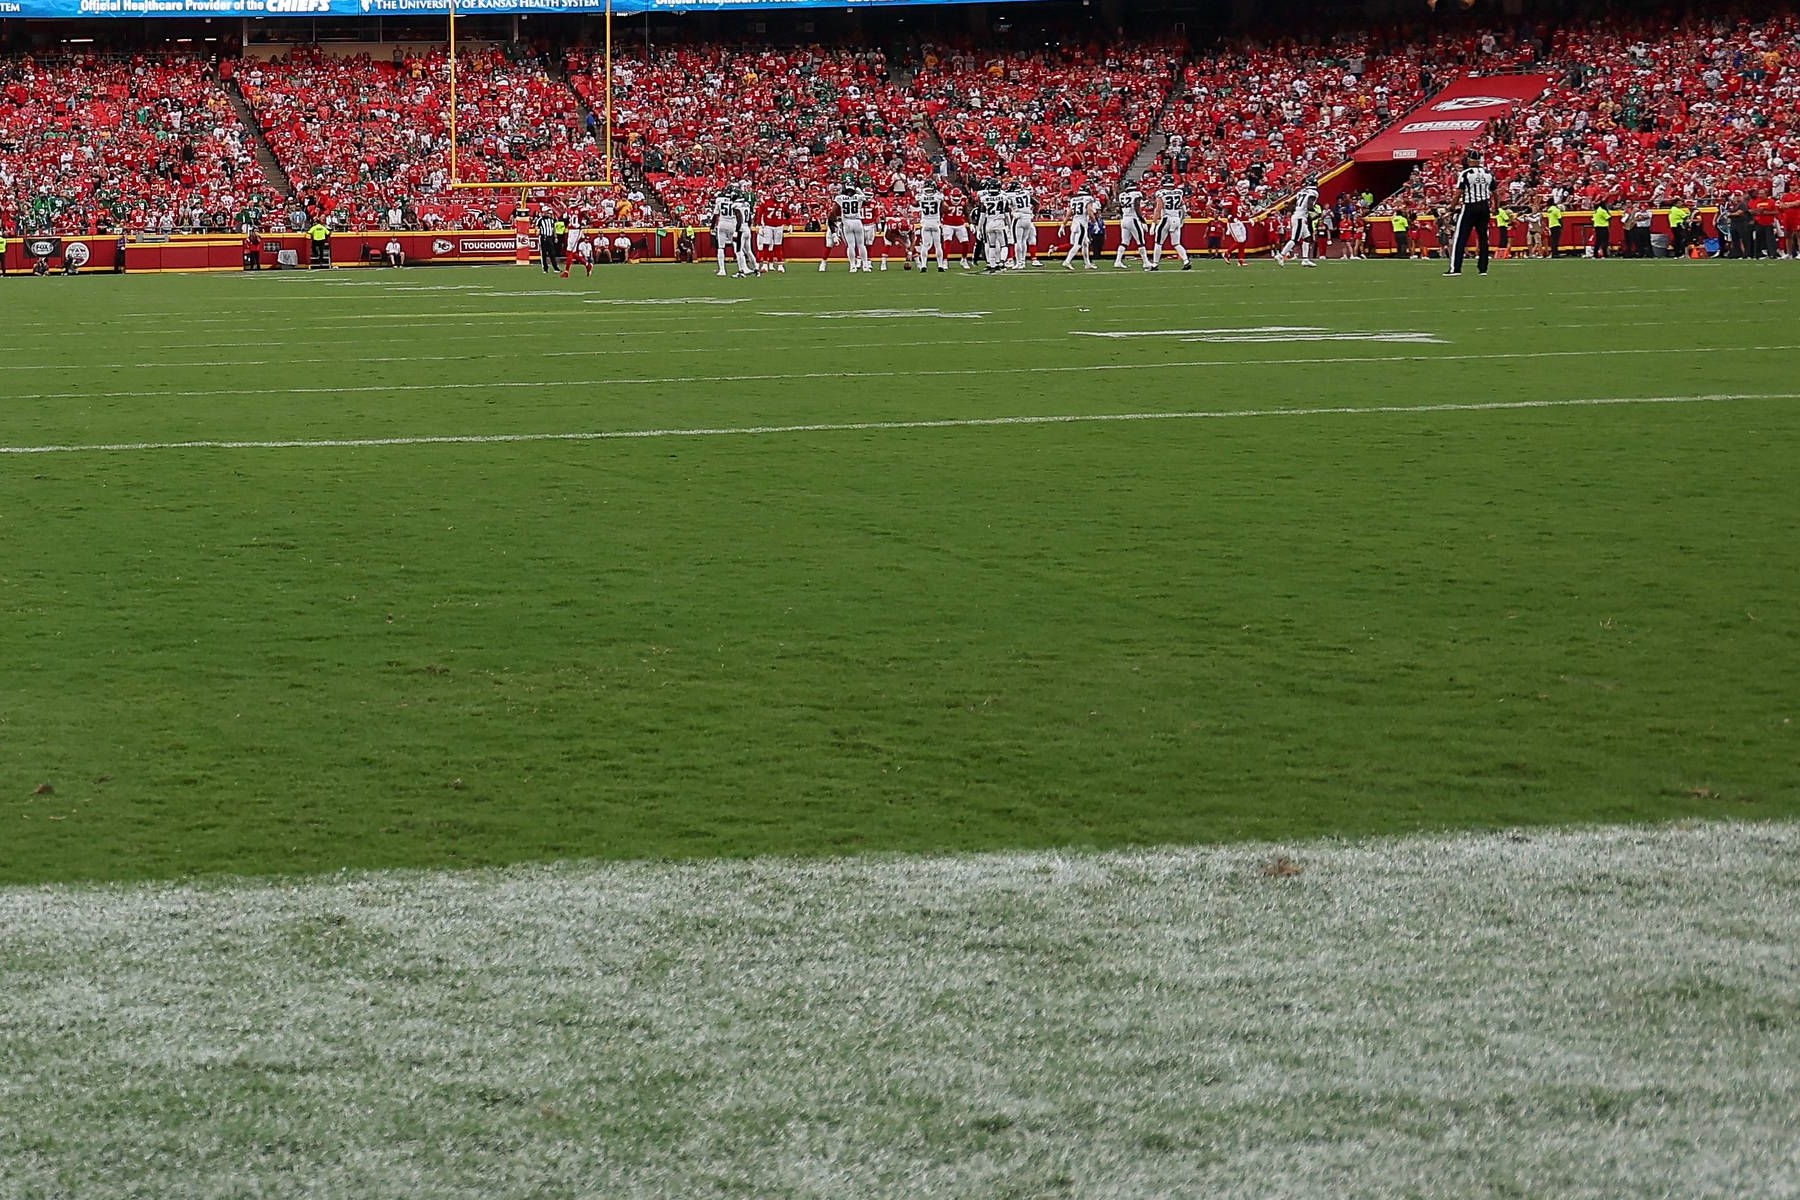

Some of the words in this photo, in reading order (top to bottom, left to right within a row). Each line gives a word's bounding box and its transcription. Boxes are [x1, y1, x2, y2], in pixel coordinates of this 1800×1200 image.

[843, 202, 858, 215] 98
[986, 200, 1004, 216] 24
[1165, 197, 1180, 209] 32
[922, 204, 938, 215] 53
[948, 207, 962, 216] 76
